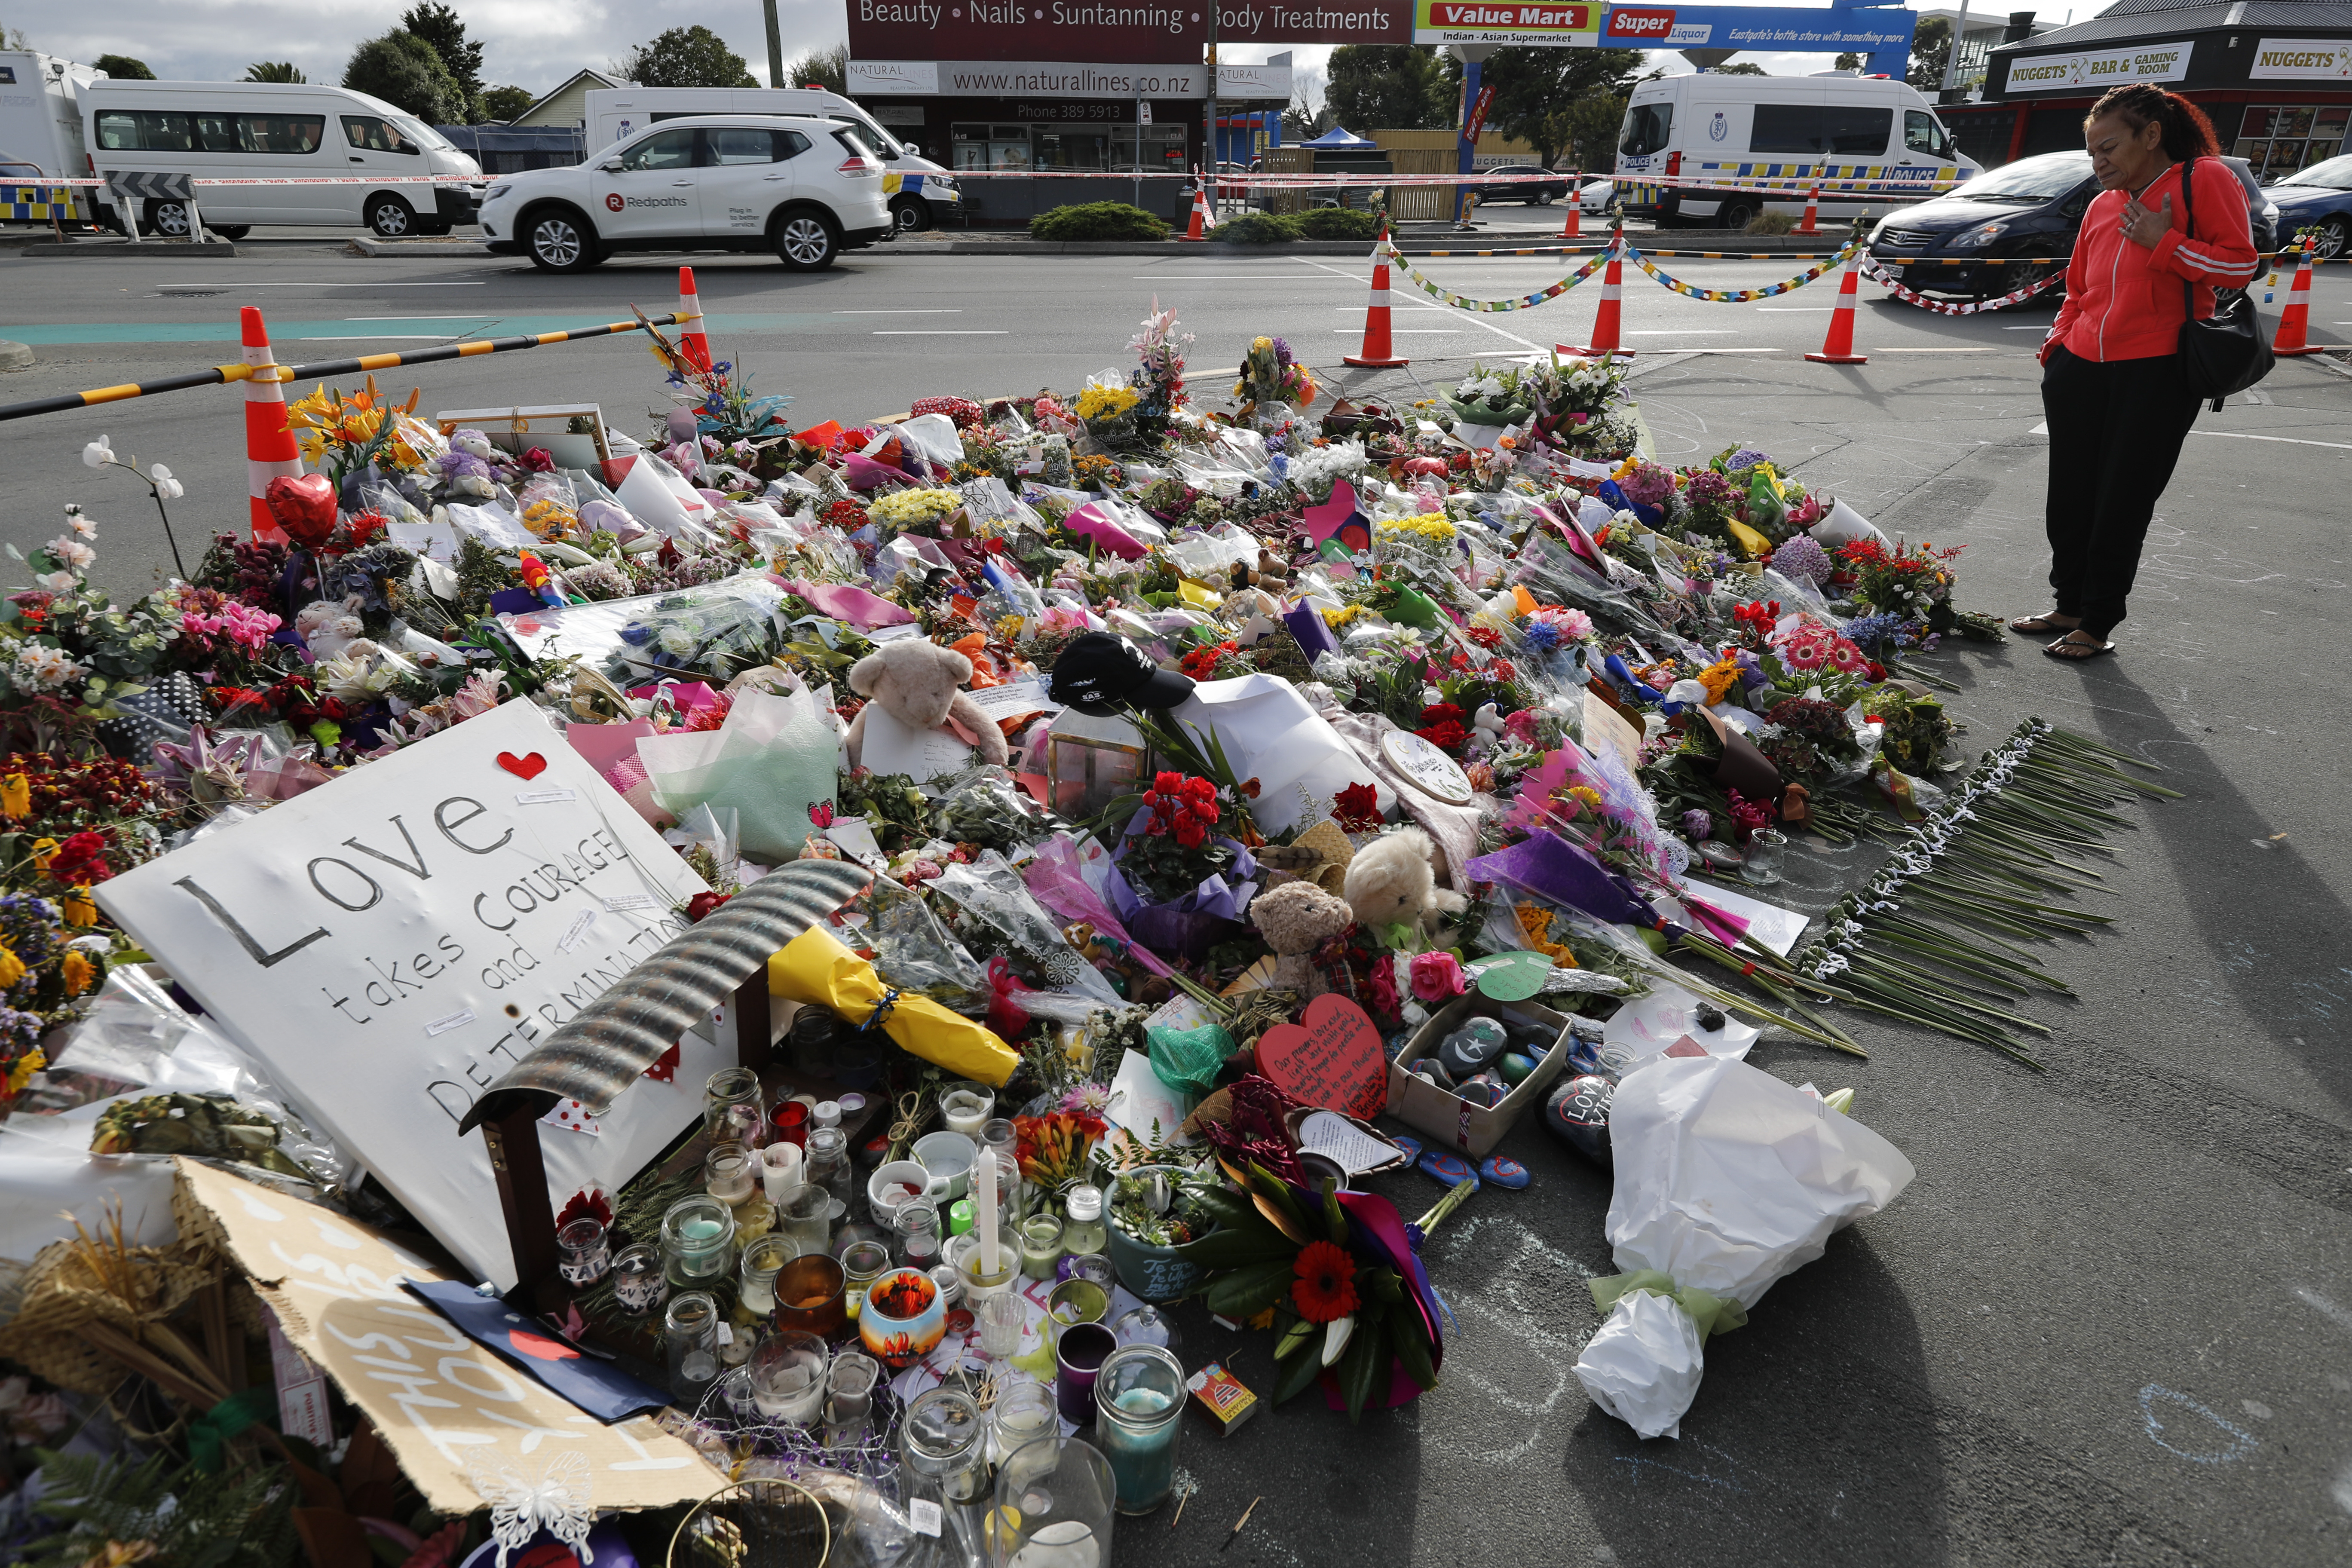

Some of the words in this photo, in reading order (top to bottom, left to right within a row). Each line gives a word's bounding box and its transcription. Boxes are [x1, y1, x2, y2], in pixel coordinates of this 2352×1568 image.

[861, 1, 941, 29] Beauty
[970, 1, 1025, 24] Nails
[1053, 1, 1183, 34] Suntanning
[1270, 6, 1389, 30] Treatments
[1445, 6, 1513, 23] Value
[1519, 8, 1574, 25] Mart
[1615, 13, 1669, 32] Super
[1442, 32, 1473, 41] Indian
[1481, 33, 1508, 42] Asian
[1511, 33, 1571, 43] Supermarket
[1671, 27, 1707, 41] Liquor
[1729, 28, 1771, 43] Eastgate's
[1774, 29, 1797, 41] bottle
[1799, 31, 1821, 42] store
[1823, 32, 1841, 42] with
[1842, 33, 1883, 46] something
[1885, 35, 1904, 43] more
[2011, 65, 2067, 82] NUGGETS
[2090, 58, 2116, 74] BAR
[2119, 59, 2130, 73] &
[2135, 52, 2179, 65] GAMING
[2259, 52, 2335, 67] NUGGETS
[850, 65, 903, 74] NATURAL
[904, 70, 934, 79] LINES
[1218, 70, 1259, 79] ATURAL
[1260, 74, 1287, 83] LINES
[2137, 63, 2170, 75] ROOM
[953, 70, 1190, 93] www.naturallines.co.nz
[1018, 105, 1056, 117] Phone
[1061, 105, 1084, 117] 389
[1089, 106, 1120, 118] 5913
[1626, 157, 1649, 166] POLICE
[627, 196, 687, 208] Redpaths
[172, 795, 514, 968] Love
[321, 932, 465, 1024] takes
[473, 828, 629, 931] COURAGE
[481, 934, 541, 990] and
[1274, 1057, 1291, 1071] Our
[325, 1321, 498, 1466] THIS
